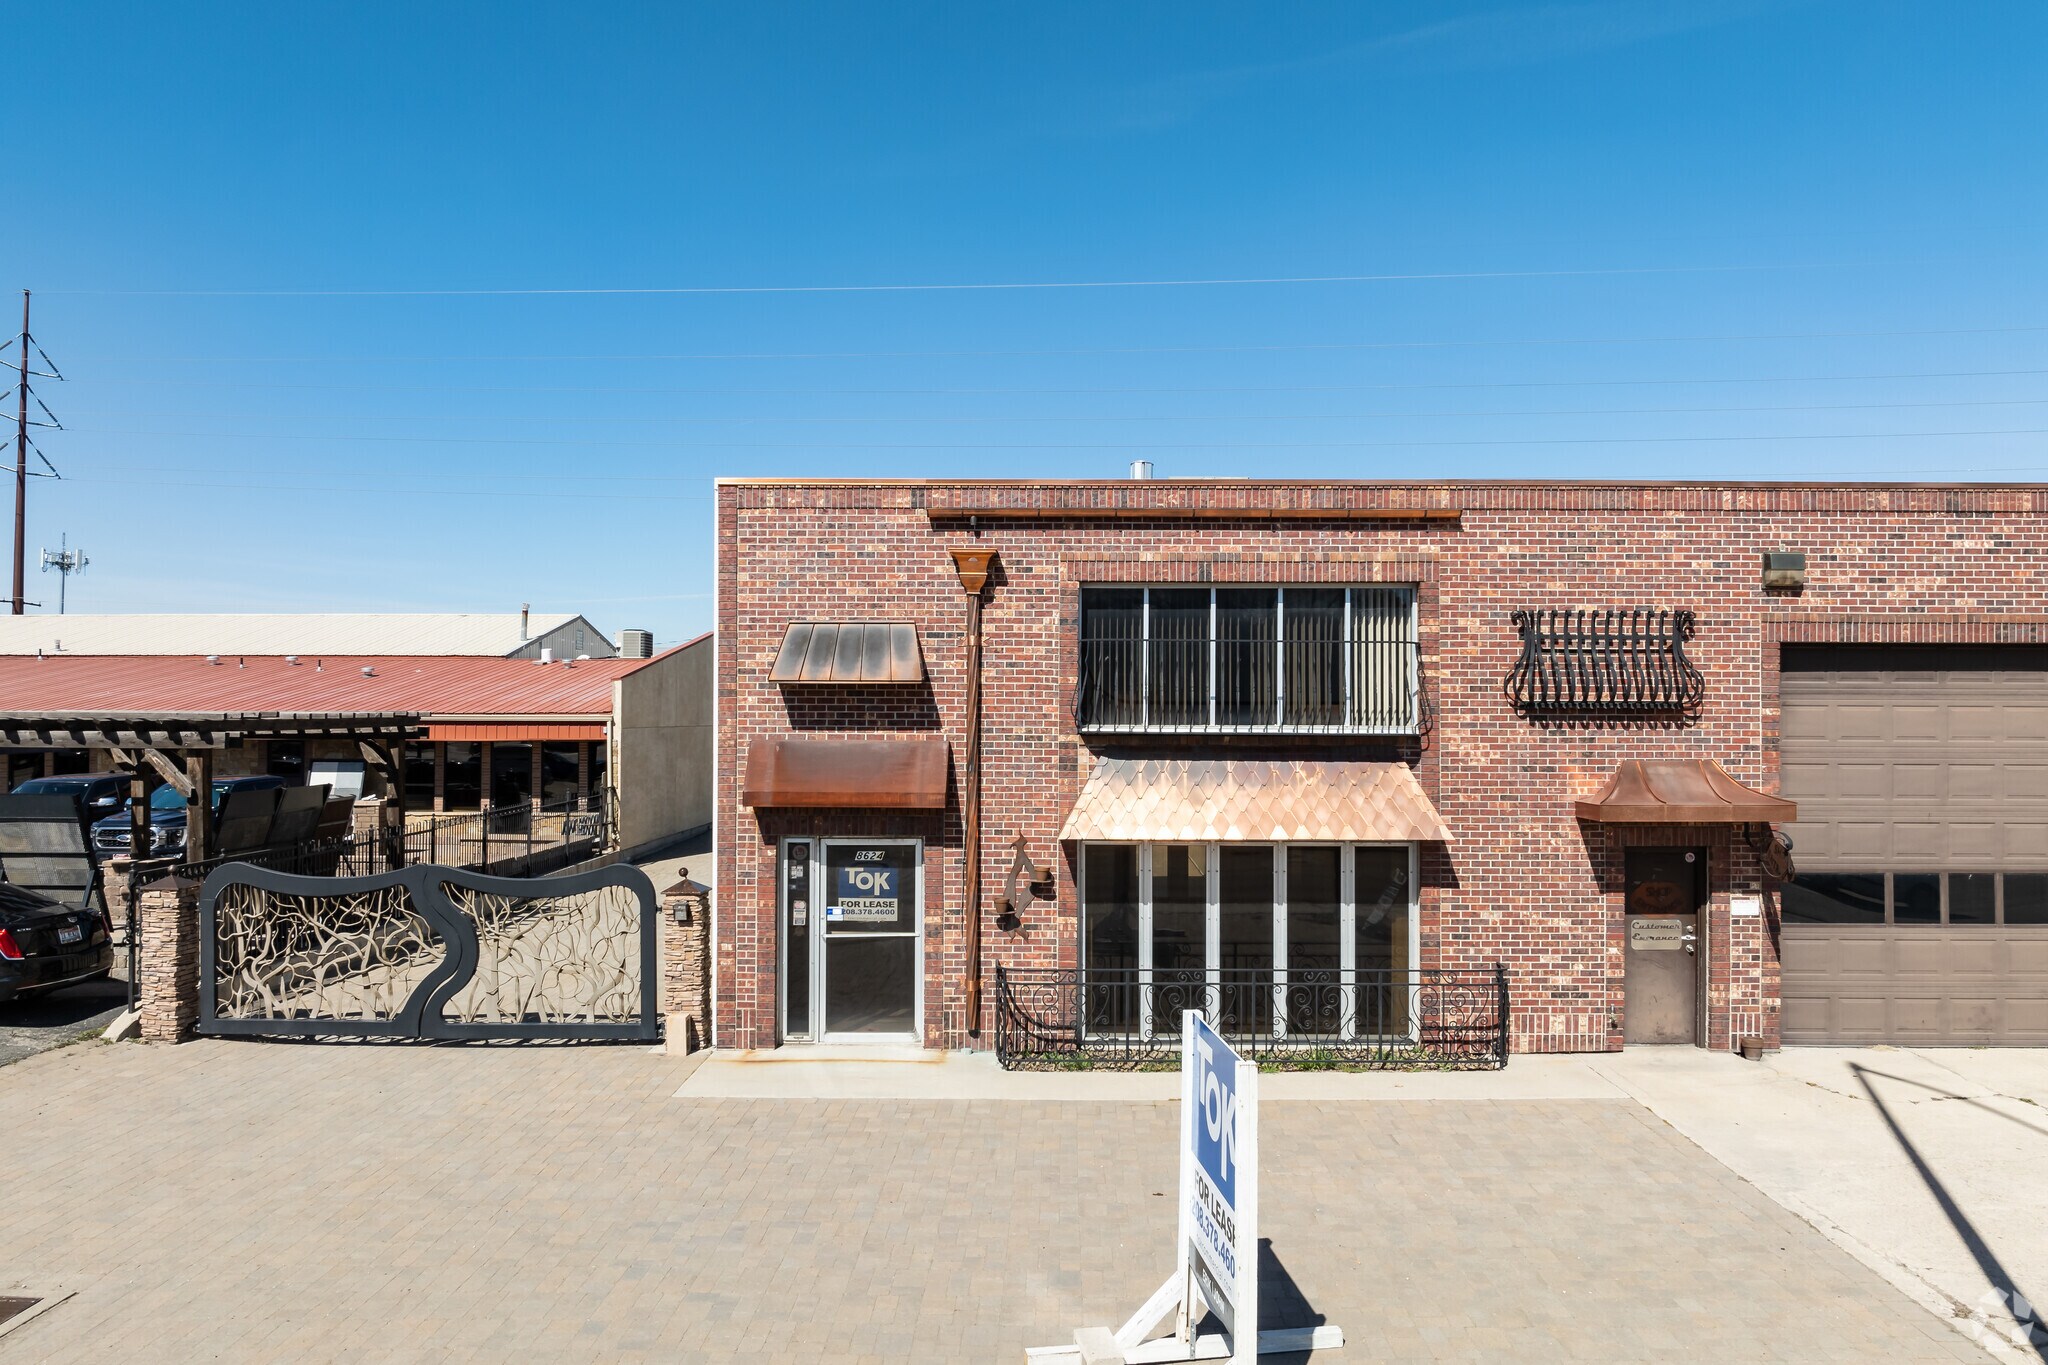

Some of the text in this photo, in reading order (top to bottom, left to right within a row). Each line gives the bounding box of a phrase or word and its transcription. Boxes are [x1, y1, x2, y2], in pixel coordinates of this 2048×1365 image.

[856, 851, 885, 860] 8624
[845, 867, 890, 896] TOK
[1632, 921, 1680, 929] Customer
[1197, 1034, 1235, 1182] TOK
[1195, 1168, 1210, 1210] FOR
[1192, 1195, 1235, 1279] 208.378.460
